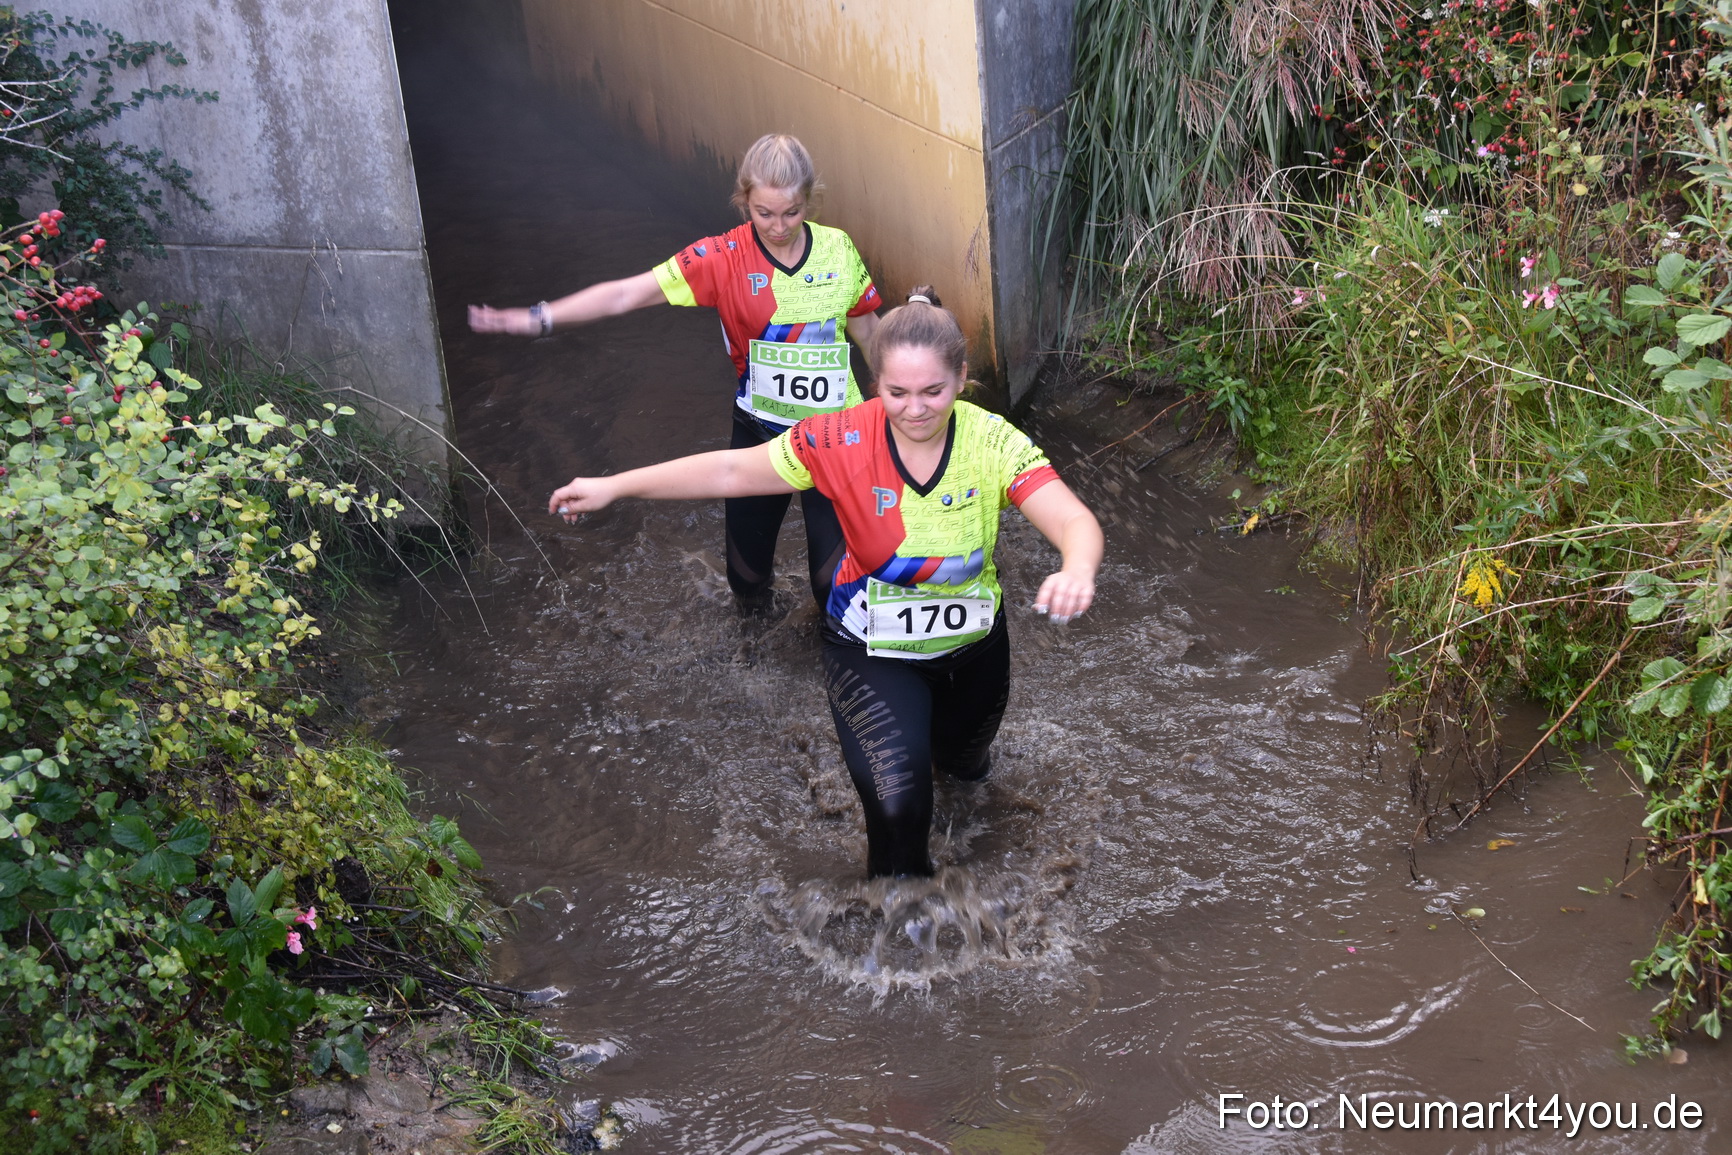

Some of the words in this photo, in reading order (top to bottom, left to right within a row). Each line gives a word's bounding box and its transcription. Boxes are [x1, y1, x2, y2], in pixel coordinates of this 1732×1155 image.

[757, 344, 843, 369] BOCK
[772, 373, 829, 402] 160
[762, 398, 796, 417] KATJA
[897, 603, 968, 634] 170
